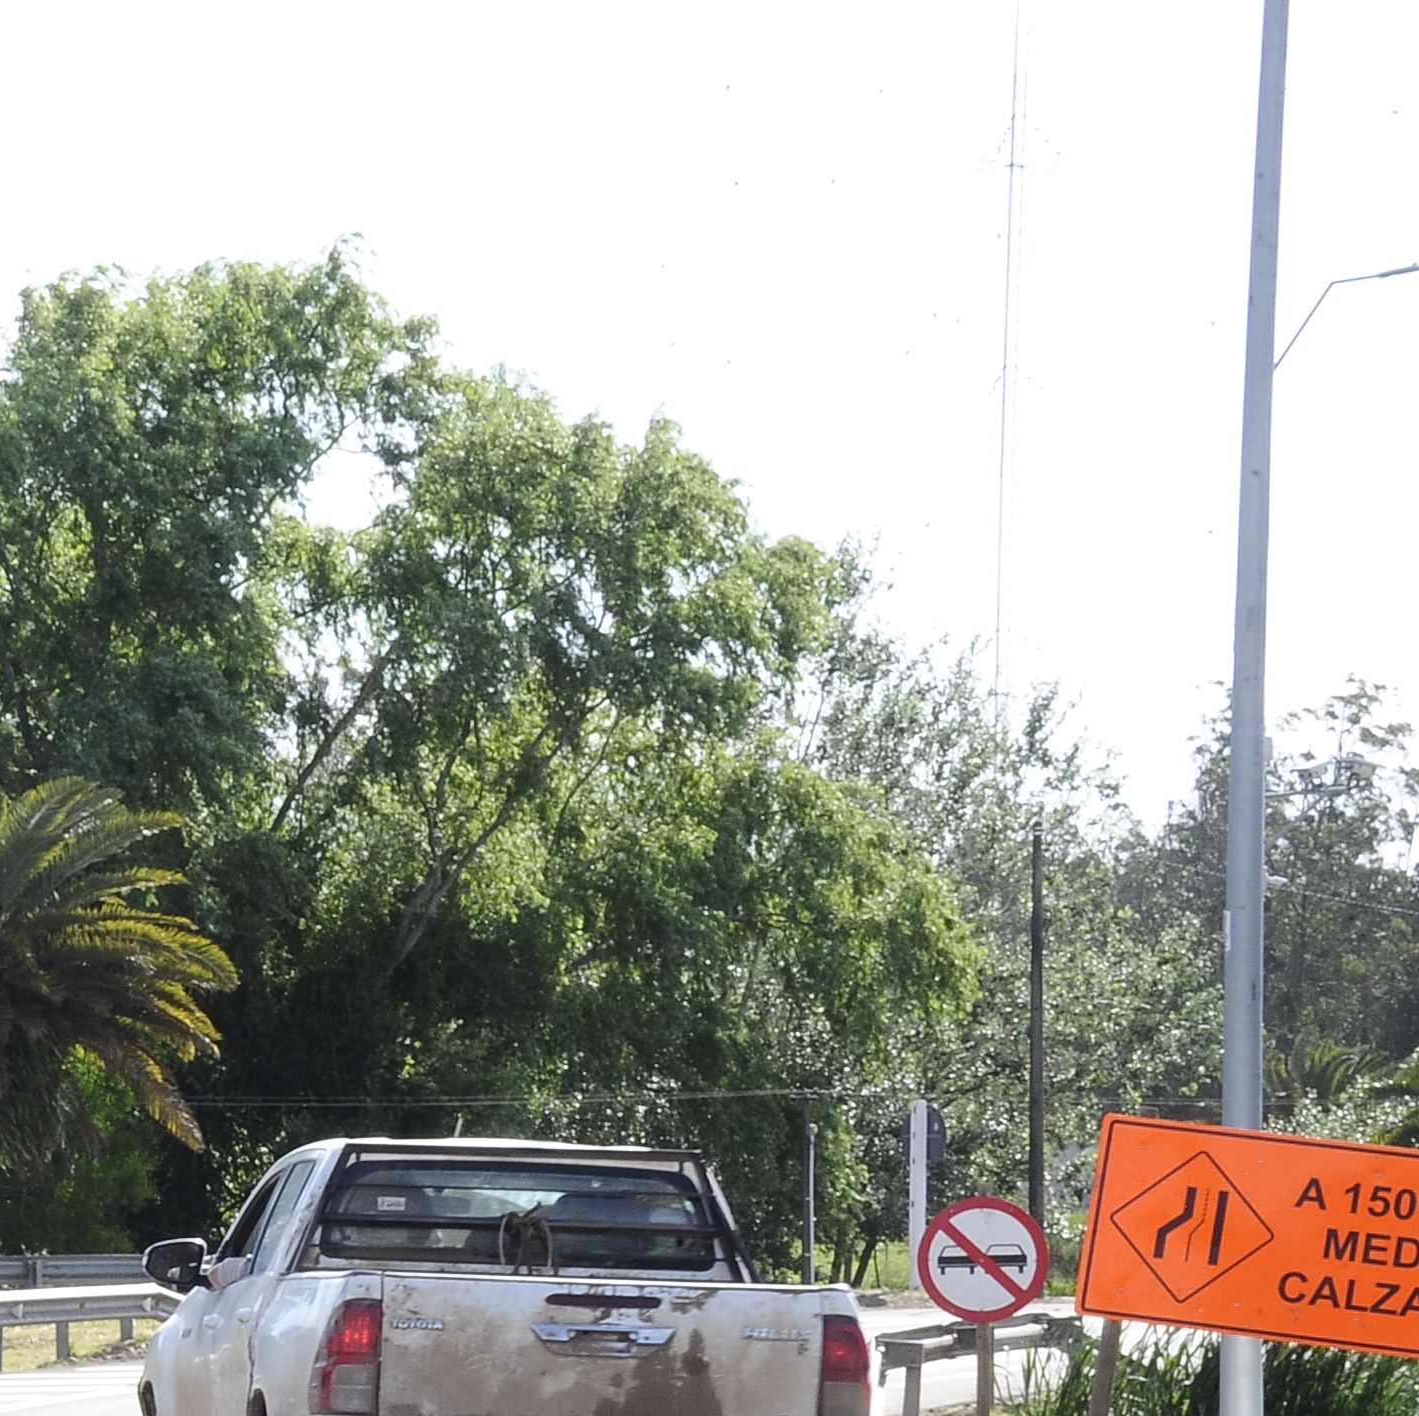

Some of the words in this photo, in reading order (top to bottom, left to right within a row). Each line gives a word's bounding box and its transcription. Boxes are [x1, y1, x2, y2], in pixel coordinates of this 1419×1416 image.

[1294, 1177, 1327, 1211] A
[1344, 1182, 1418, 1221] 150
[1323, 1227, 1419, 1269] MED
